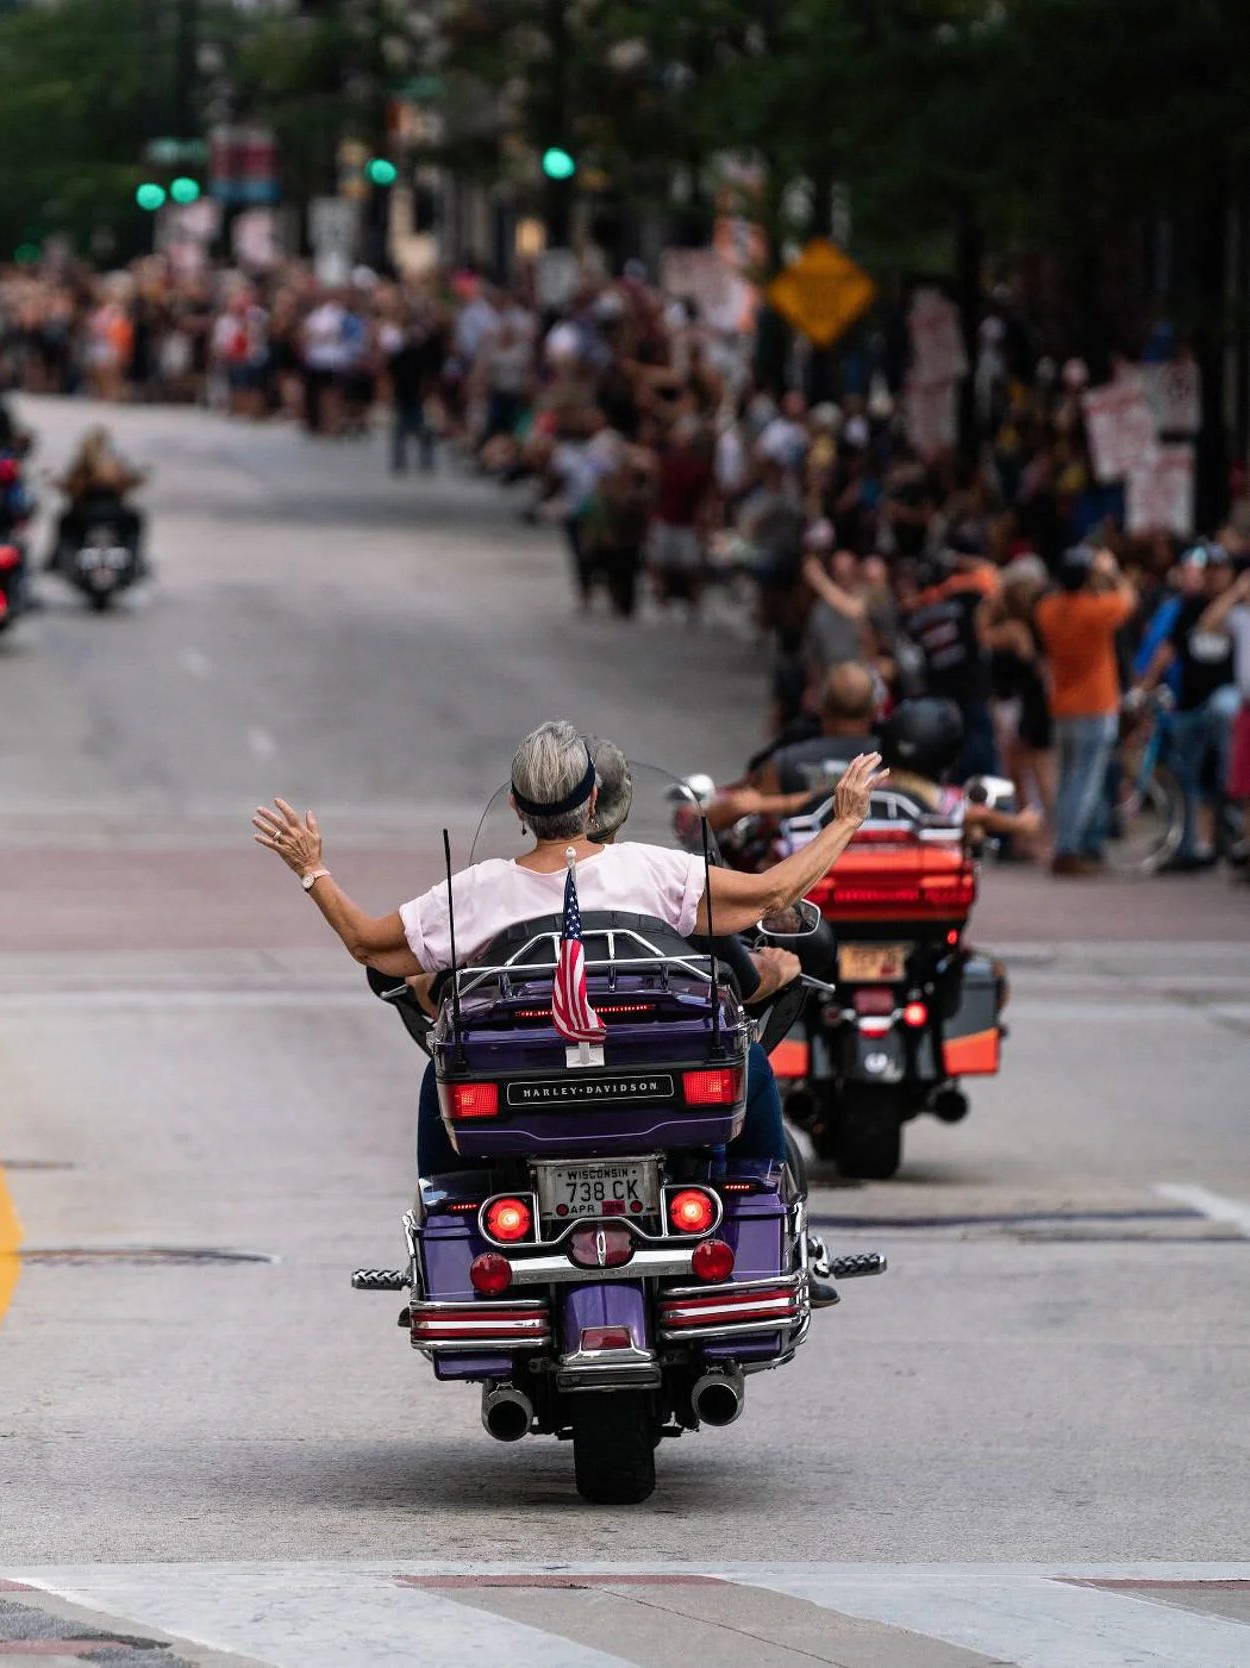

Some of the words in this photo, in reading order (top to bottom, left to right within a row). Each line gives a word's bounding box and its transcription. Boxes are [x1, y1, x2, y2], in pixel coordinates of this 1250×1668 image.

[567, 1168, 629, 1181] WISCONSIN
[565, 1181, 605, 1203] 738
[612, 1179, 639, 1200] CK
[570, 1204, 595, 1214] APR
